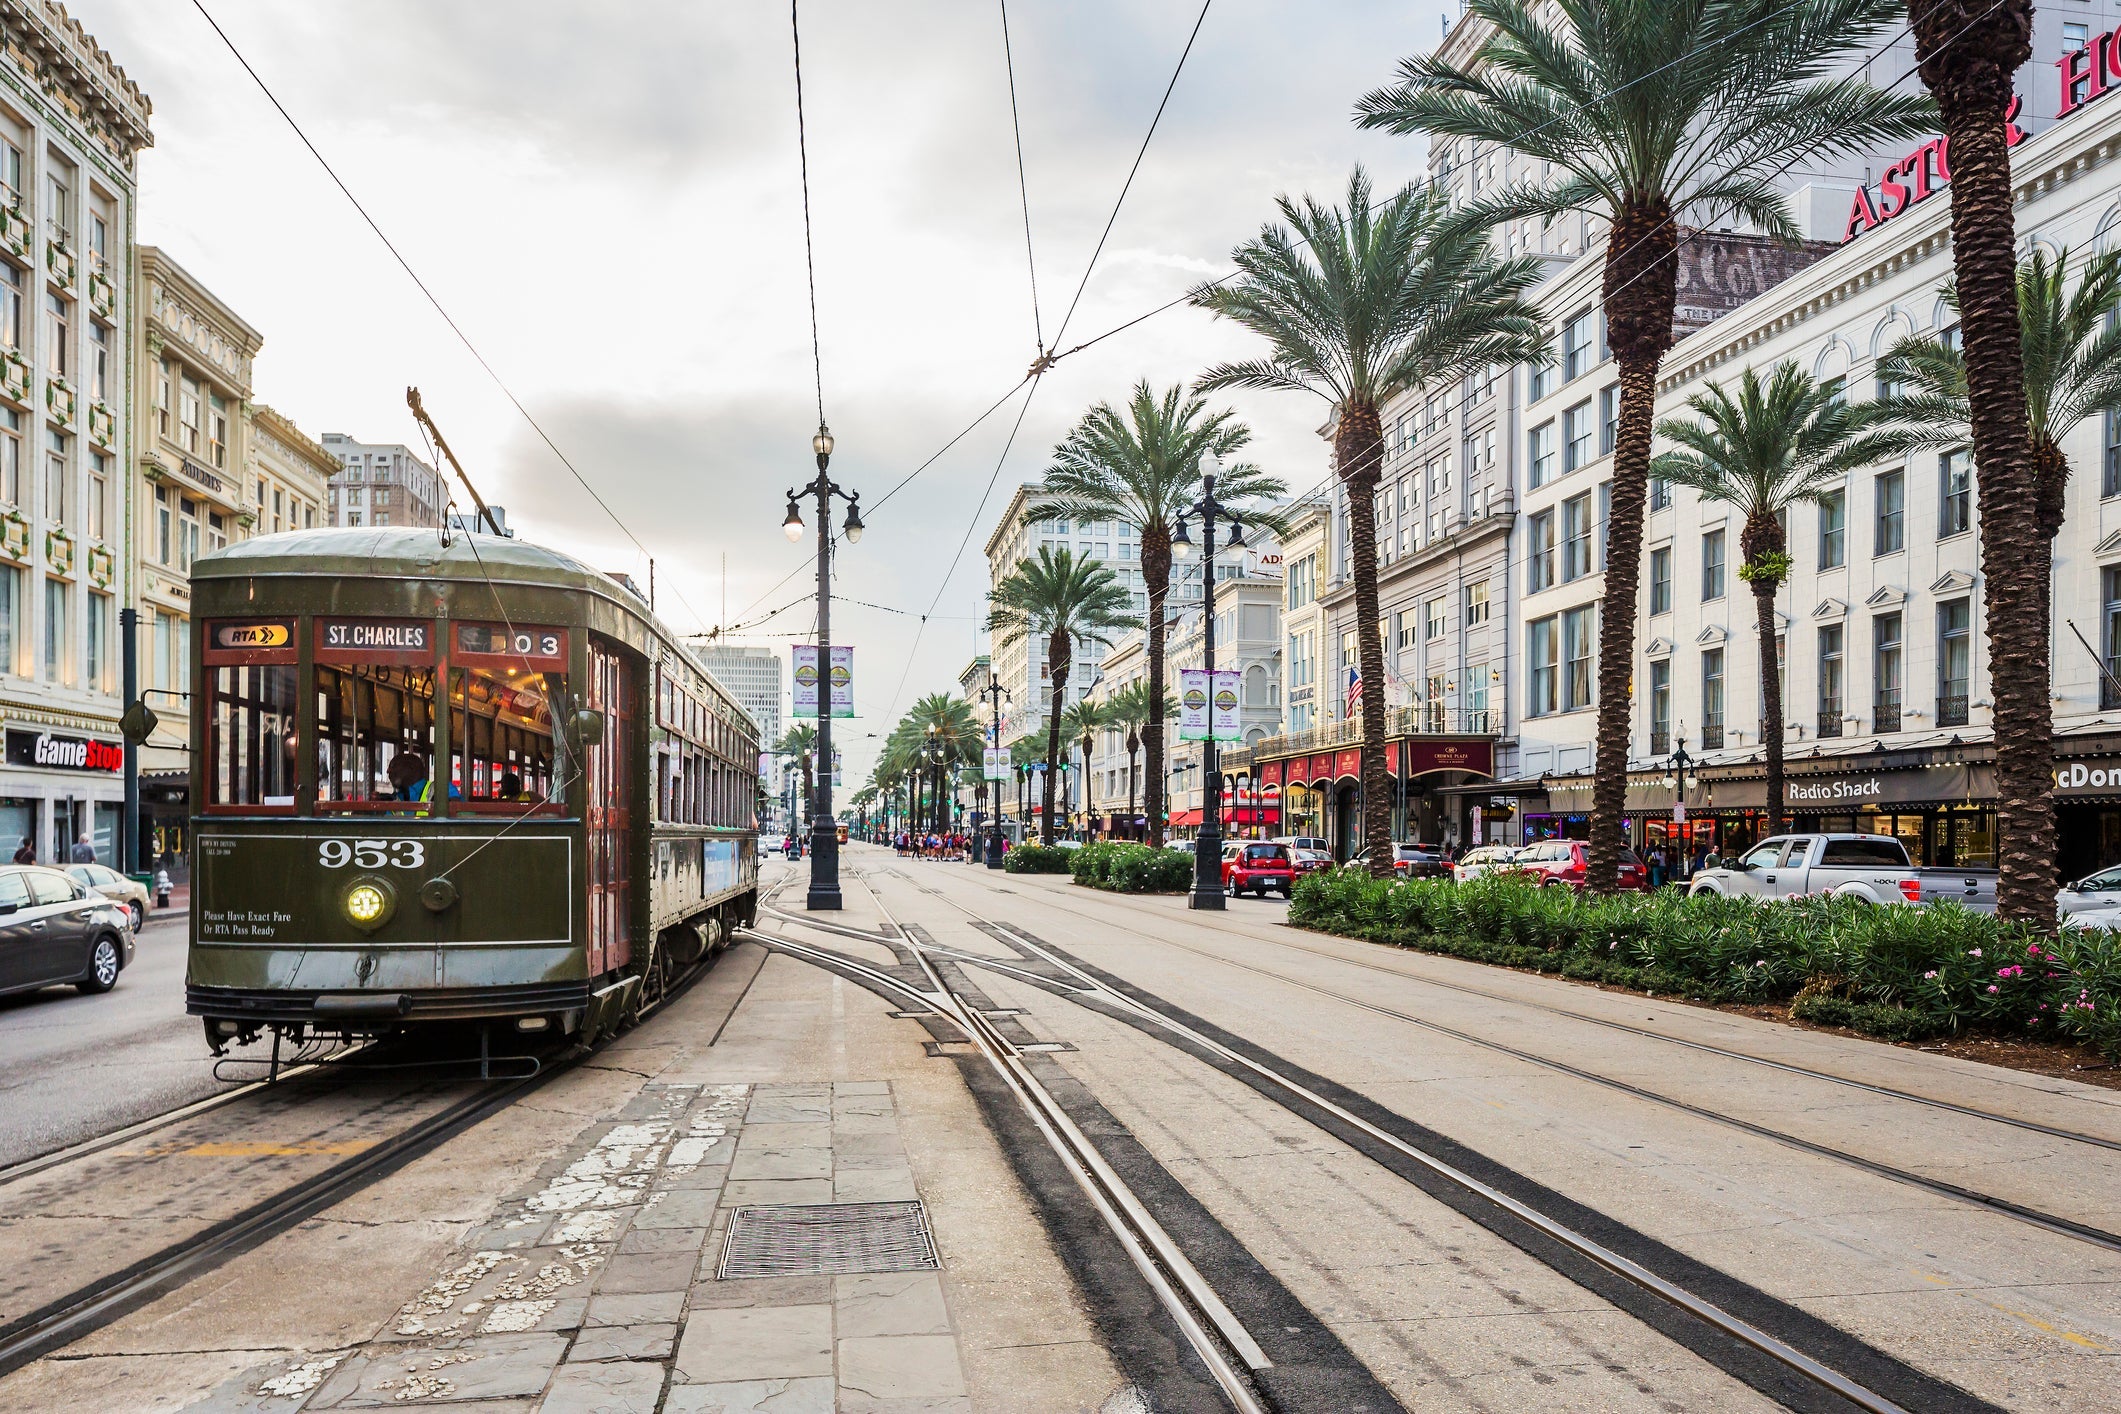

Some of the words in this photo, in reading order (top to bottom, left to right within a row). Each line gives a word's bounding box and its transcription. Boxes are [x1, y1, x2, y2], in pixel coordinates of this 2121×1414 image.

[232, 630, 256, 642] RTA
[329, 626, 350, 644] ST.
[353, 626, 424, 647] CHARLES
[35, 735, 122, 772] GameStop
[2051, 763, 2121, 789] cDon
[1789, 783, 1832, 799] Radio
[1832, 778, 1881, 798] Shack
[319, 840, 425, 869] 953
[204, 910, 225, 921] Please
[227, 911, 245, 921] Have
[248, 911, 270, 922] Exact
[273, 911, 291, 922] Fare
[204, 924, 213, 934] Or
[215, 925, 230, 934] RTA
[232, 925, 249, 935] Pass
[251, 925, 275, 937] Ready
